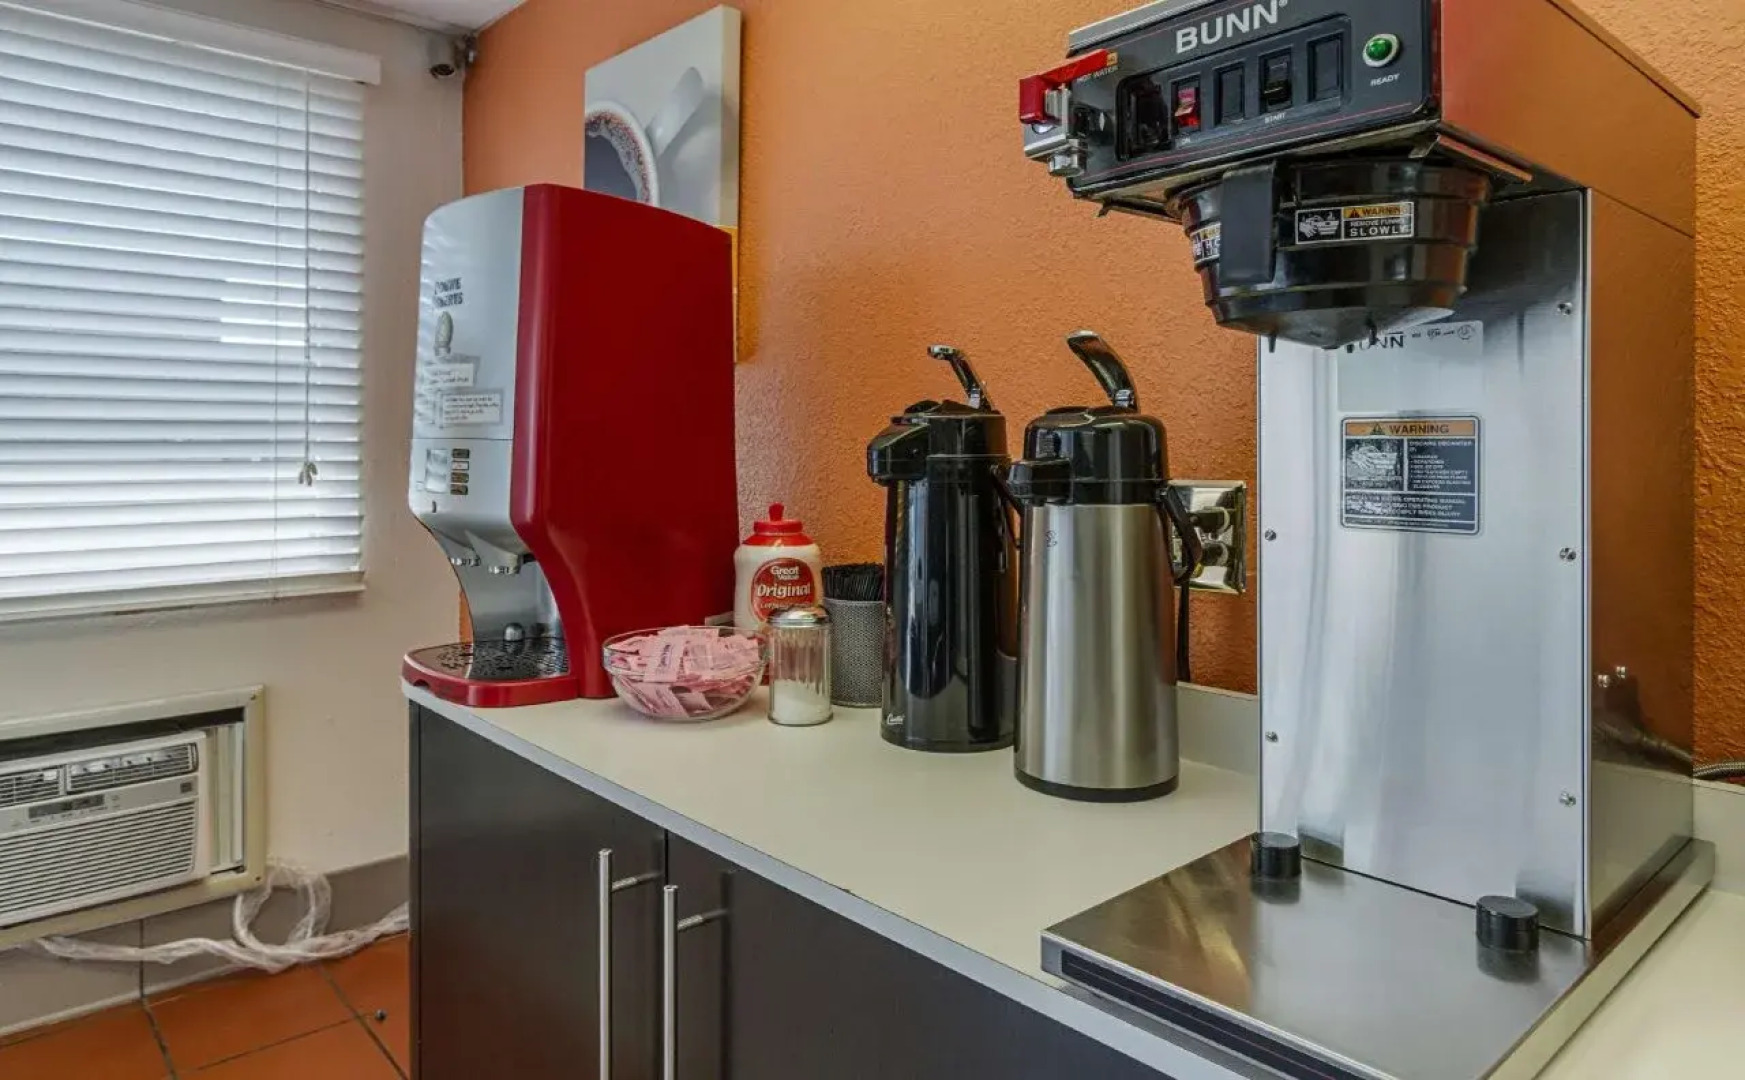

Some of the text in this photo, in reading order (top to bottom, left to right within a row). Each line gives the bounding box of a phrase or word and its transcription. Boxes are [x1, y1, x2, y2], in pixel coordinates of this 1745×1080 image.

[1175, 1, 1281, 54] BUNN
[1369, 73, 1400, 87] READY
[1264, 112, 1286, 124] START
[1350, 224, 1409, 237] SLOWLY
[1388, 424, 1450, 435] WARNING
[771, 565, 799, 575] Great
[757, 582, 811, 599] Original
